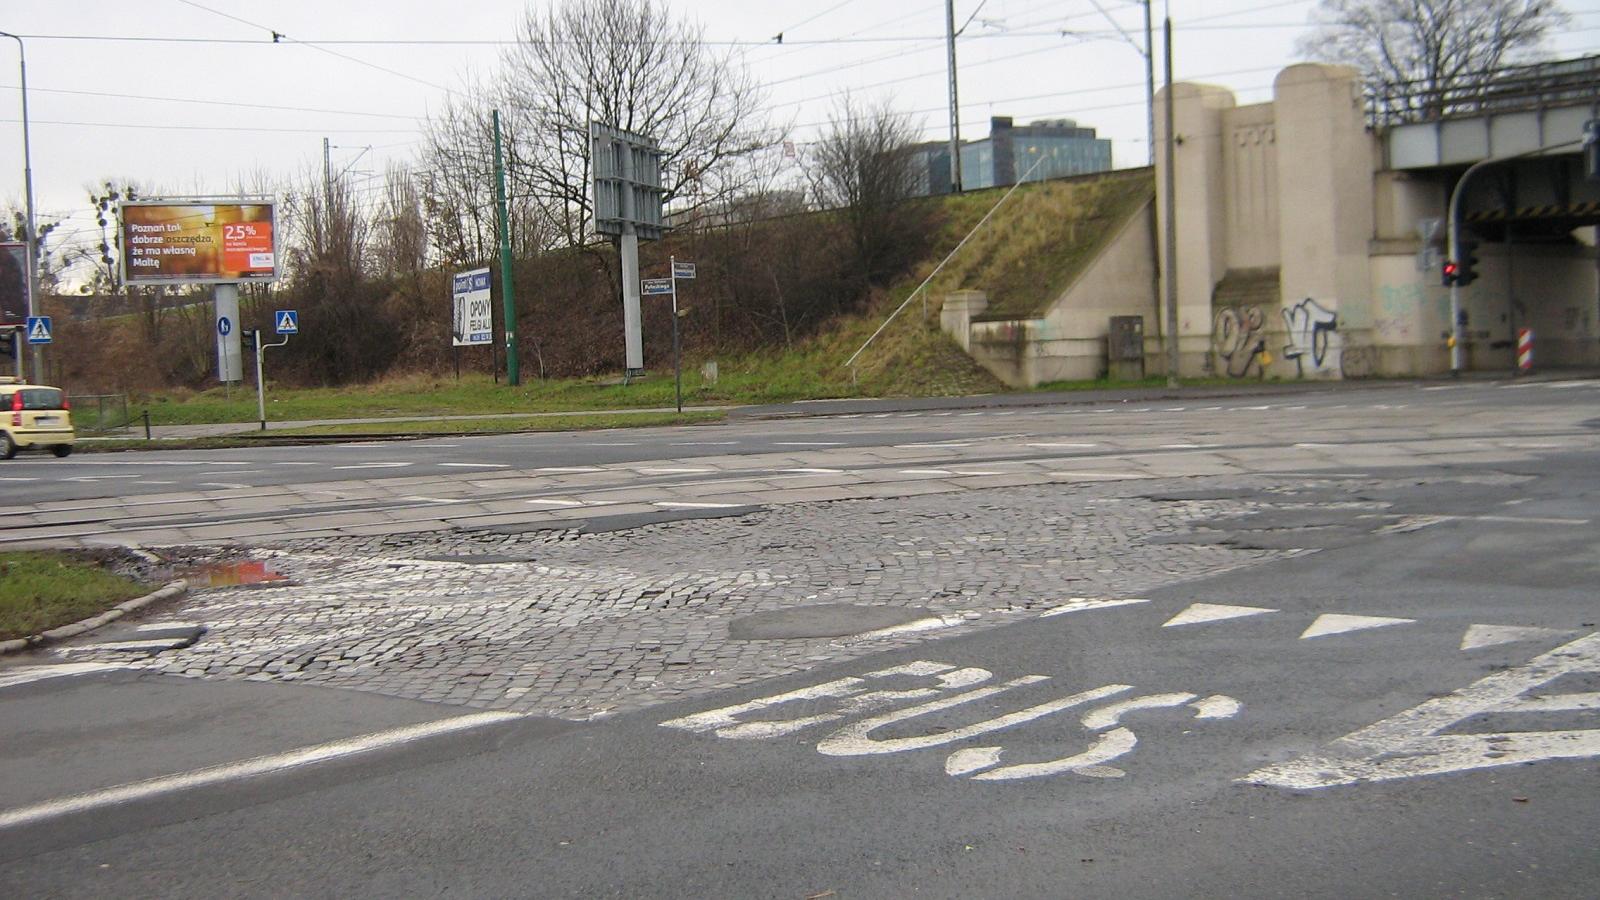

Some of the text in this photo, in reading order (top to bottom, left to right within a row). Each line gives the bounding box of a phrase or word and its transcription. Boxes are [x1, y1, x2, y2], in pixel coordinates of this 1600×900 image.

[132, 224, 182, 232] Poznań tak
[132, 235, 163, 244] dobrze
[132, 247, 143, 255] że
[163, 246, 196, 256] własną
[133, 258, 160, 268] Maltę
[470, 300, 491, 317] OPONY
[657, 660, 1242, 779] BUS
